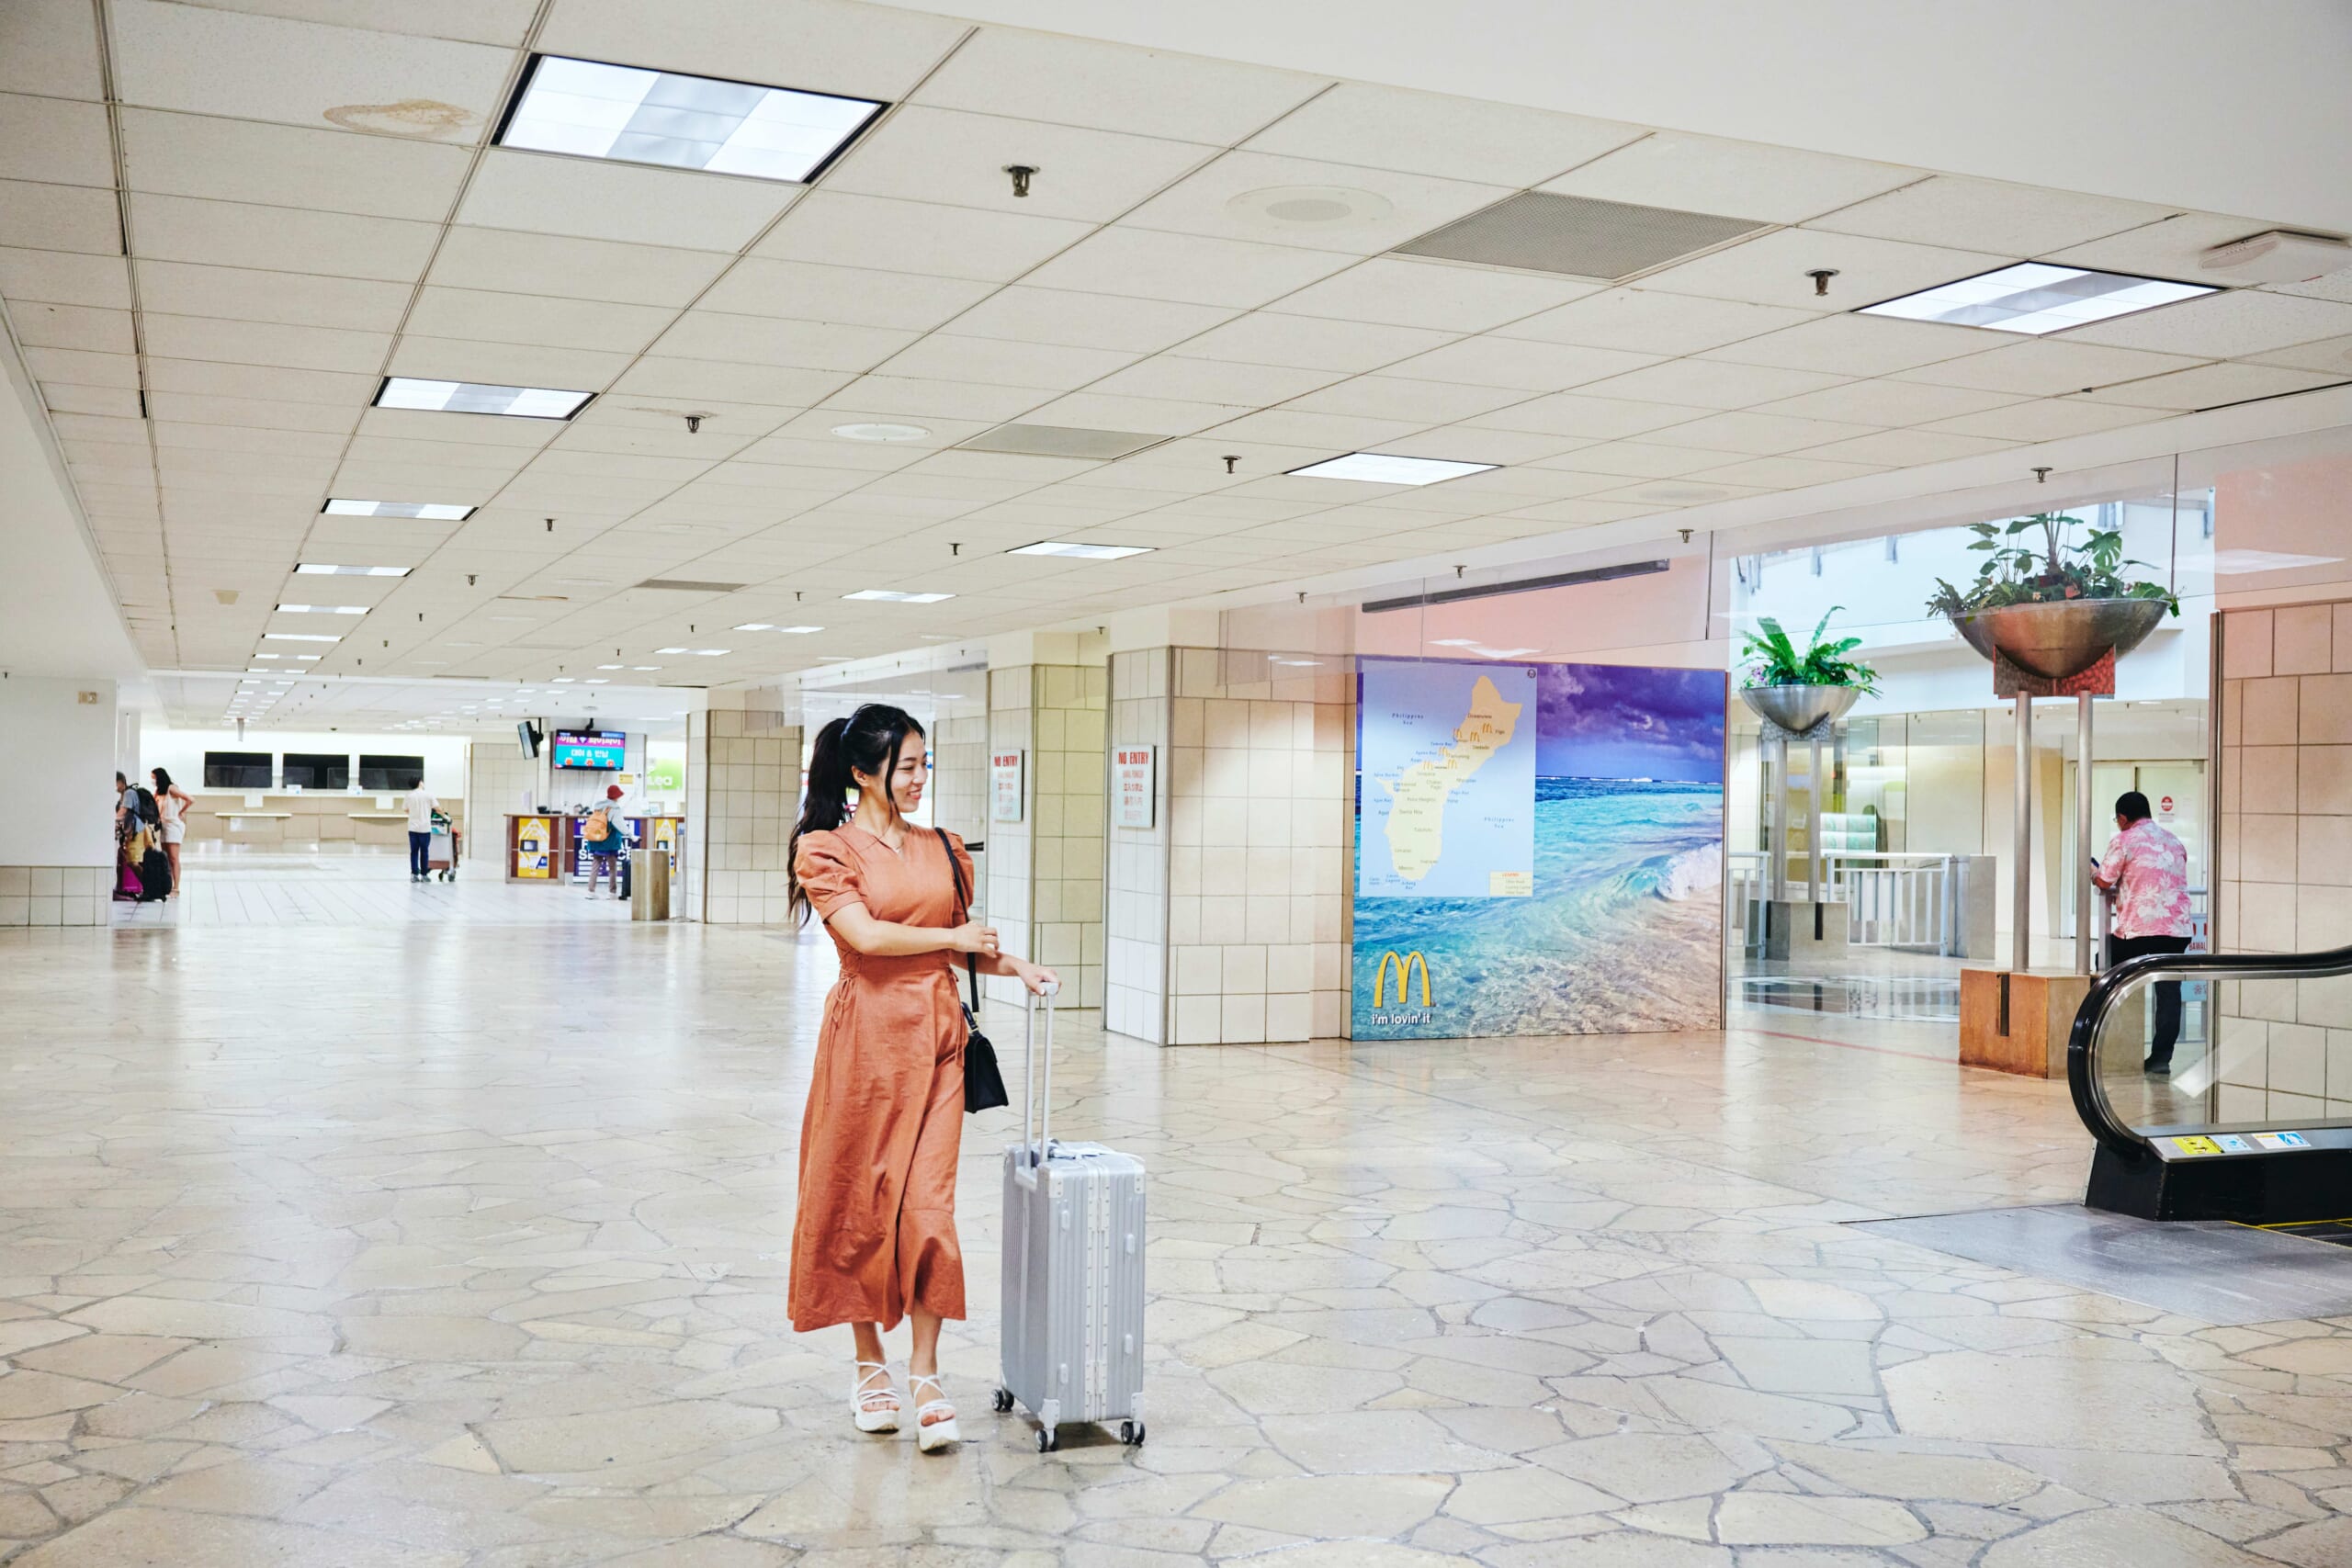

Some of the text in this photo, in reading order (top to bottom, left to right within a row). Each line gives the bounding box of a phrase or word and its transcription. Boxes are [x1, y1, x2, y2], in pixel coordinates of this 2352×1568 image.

[994, 755, 1018, 767] NO ENTRY
[1118, 751, 1148, 764] NO ENTRY
[1372, 1012, 1431, 1024] i'm lovin' it
